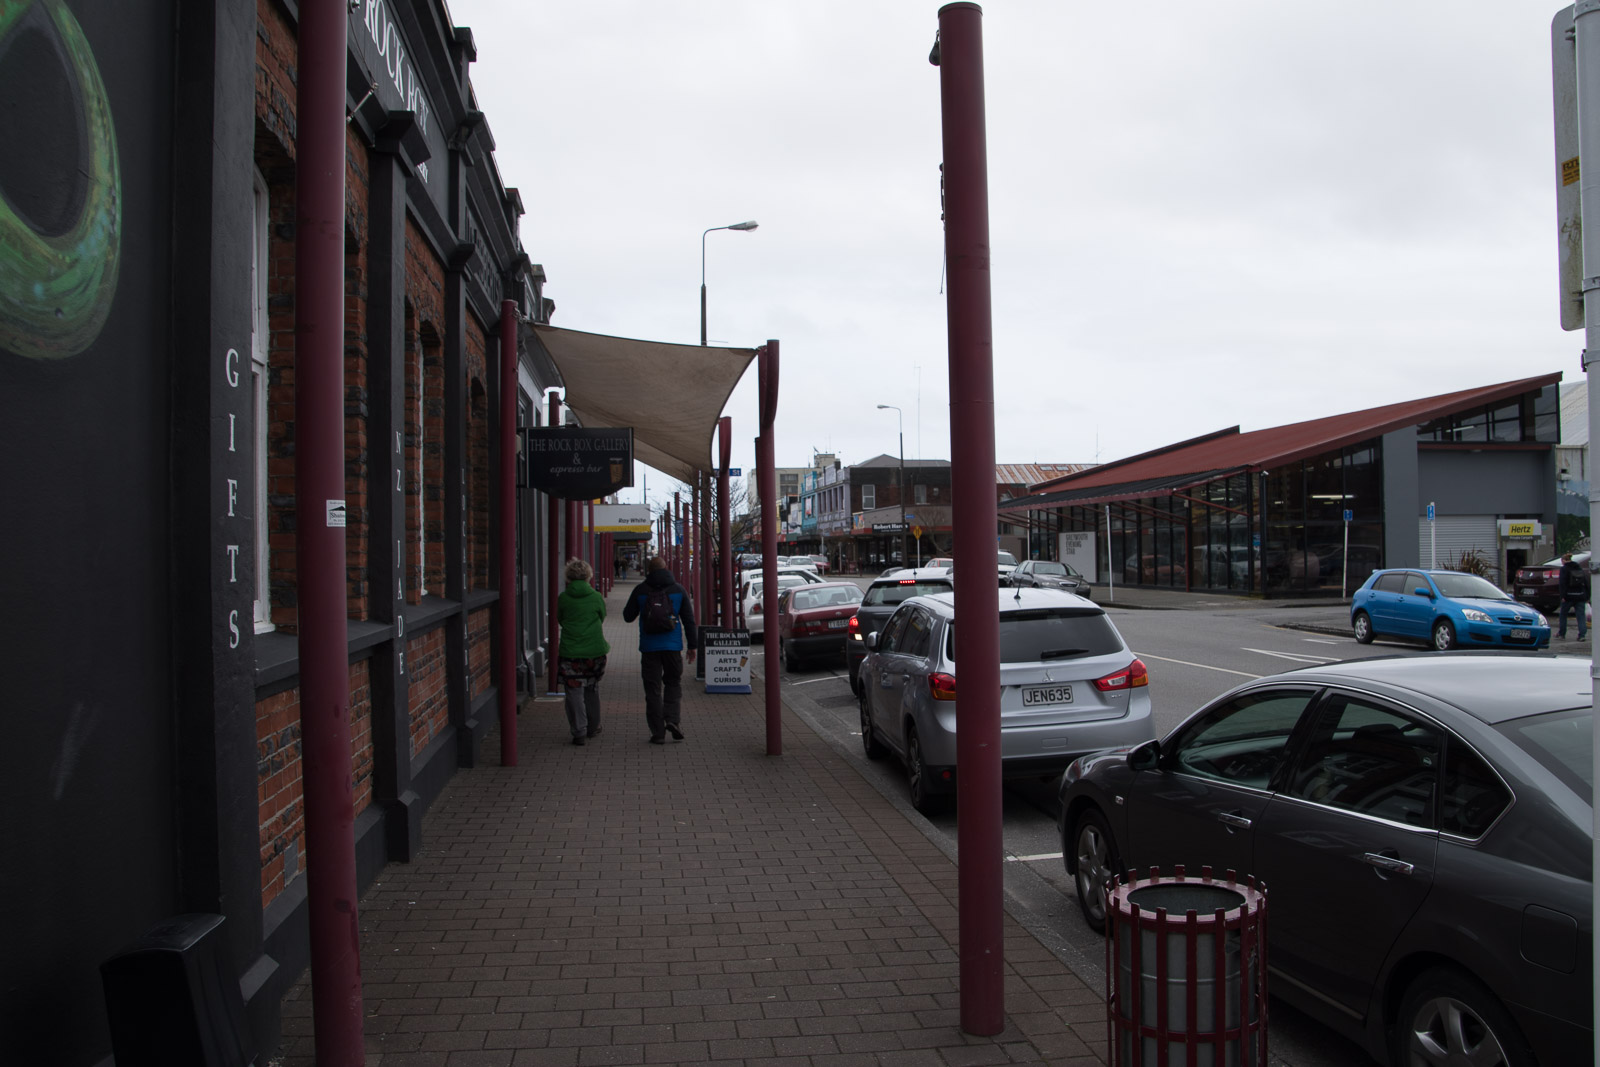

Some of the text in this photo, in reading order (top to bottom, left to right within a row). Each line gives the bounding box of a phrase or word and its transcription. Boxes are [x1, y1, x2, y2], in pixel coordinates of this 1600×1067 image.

[531, 438, 629, 451] THE ROCK BOX GALLERY
[396, 430, 402, 492] NZ
[573, 452, 582, 465] &
[225, 347, 240, 649] GIFTS
[1511, 525, 1531, 534] Hertz
[1026, 688, 1071, 703] JEN635
